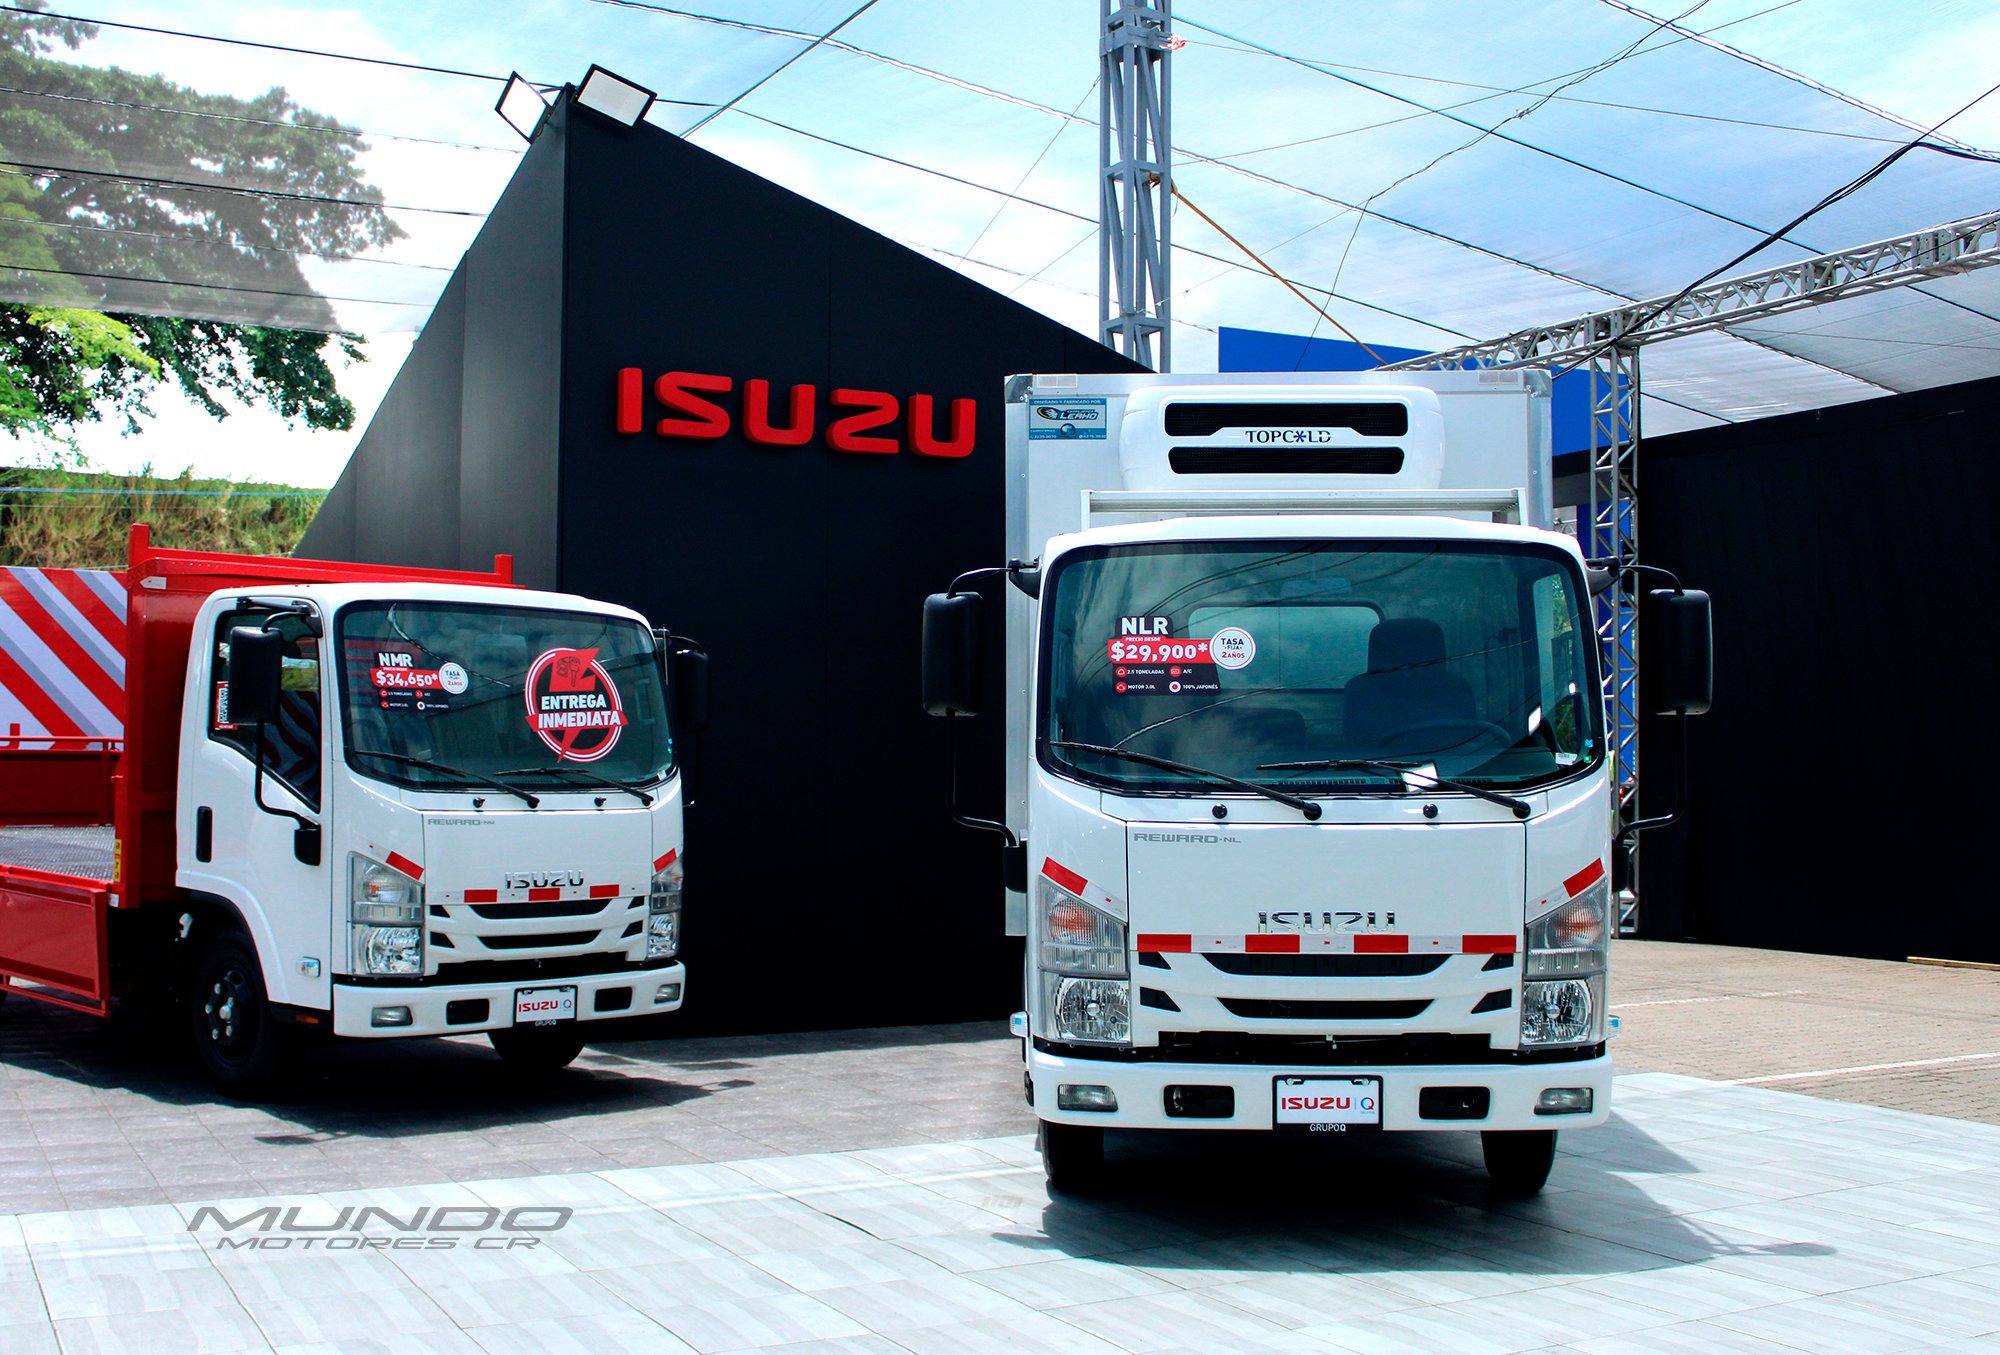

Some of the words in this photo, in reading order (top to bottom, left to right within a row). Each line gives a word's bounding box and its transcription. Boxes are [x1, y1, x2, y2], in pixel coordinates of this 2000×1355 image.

[617, 367, 976, 458] ISUZU
[1121, 617, 1168, 635] NLR
[378, 653, 413, 667] NMR
[541, 694, 607, 710] ENTREGA
[538, 710, 621, 729] INMEDIATA
[505, 869, 584, 889] ISUZU
[1257, 910, 1395, 935] ISUZU
[518, 1000, 559, 1013] ISUZU
[563, 999, 573, 1009] Q
[1281, 1097, 1350, 1110] ISUZU
[1360, 1097, 1375, 1110] Q
